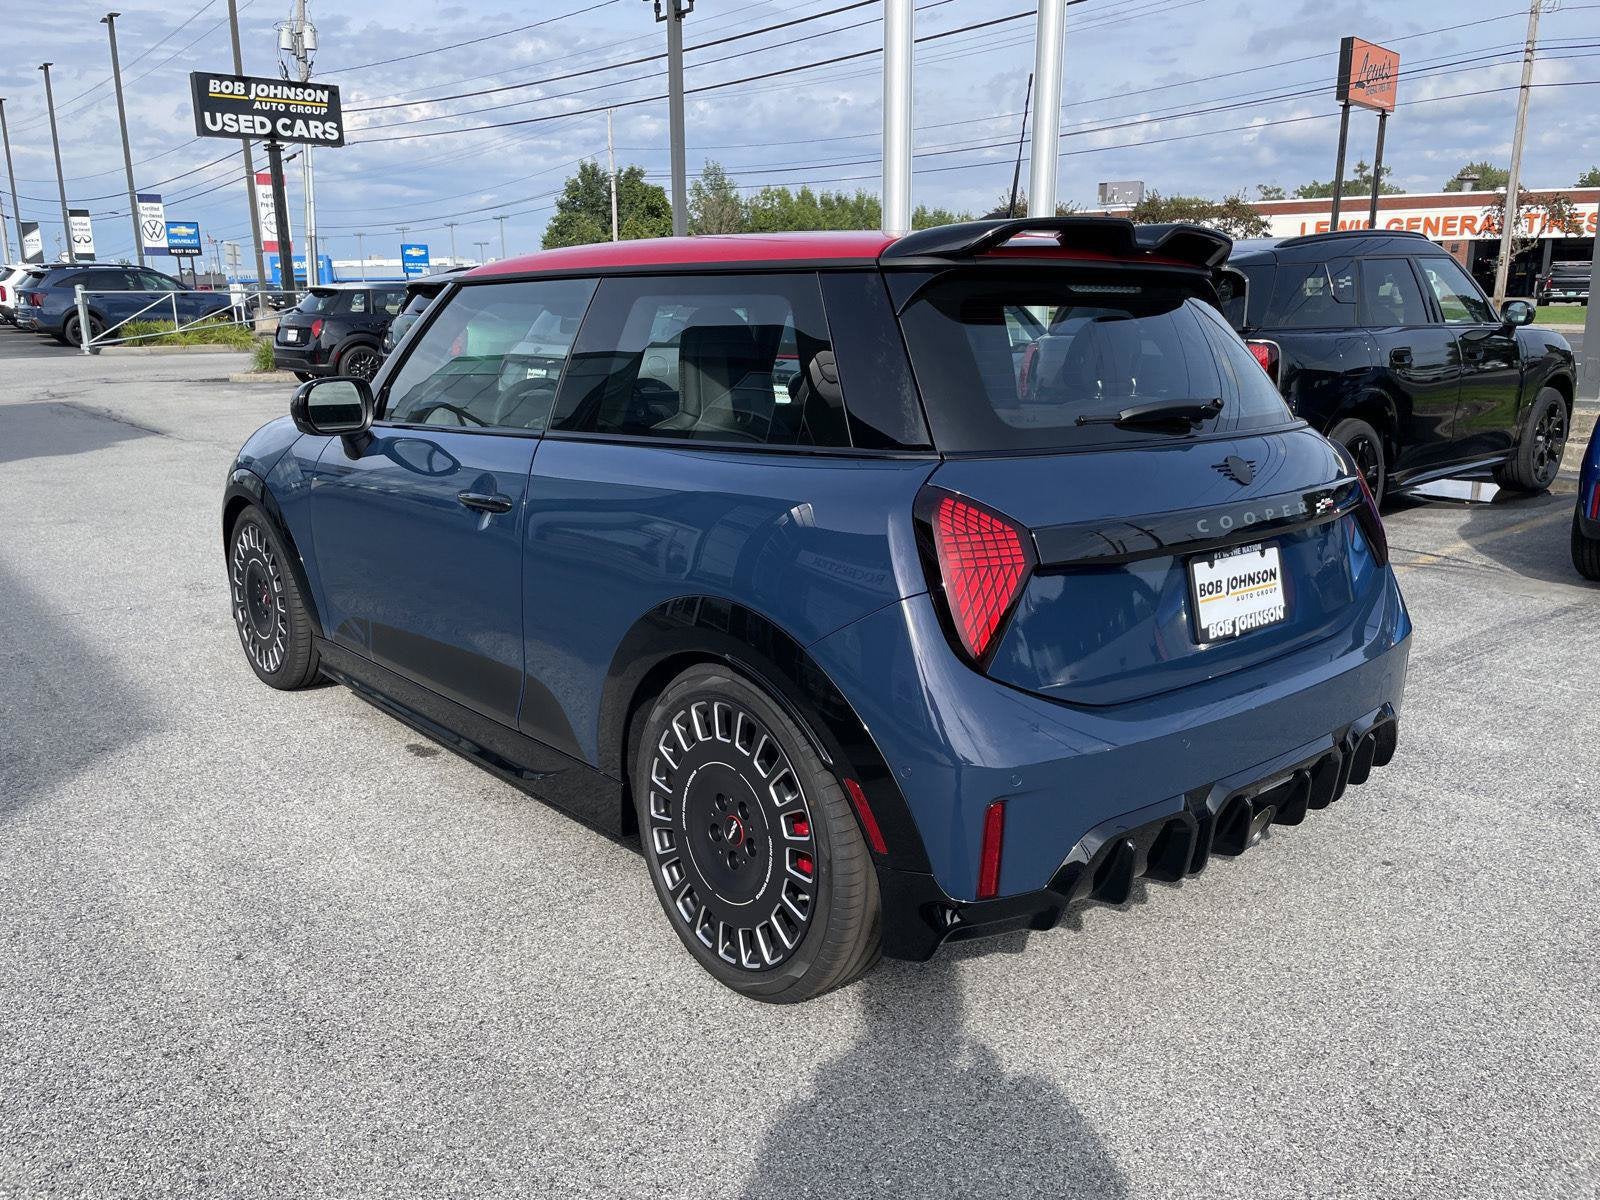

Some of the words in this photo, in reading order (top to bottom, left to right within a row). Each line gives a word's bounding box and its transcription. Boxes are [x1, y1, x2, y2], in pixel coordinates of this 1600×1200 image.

[208, 79, 246, 95] BOB
[249, 82, 329, 103] JOHNSON
[252, 101, 286, 112] AUTO
[289, 104, 328, 116] GROUP
[203, 111, 272, 135] USED
[276, 117, 340, 141] CARS
[1385, 213, 1504, 237] GENERA
[1197, 501, 1307, 531] COOPER
[1242, 543, 1262, 554] NATION
[1199, 579, 1223, 598] BOB
[1225, 567, 1277, 596] JOHNSON
[1236, 592, 1254, 602] AUTO
[1256, 587, 1277, 597] GROUP
[1208, 618, 1234, 640] BOB
[1234, 605, 1285, 636] JOHNSON
